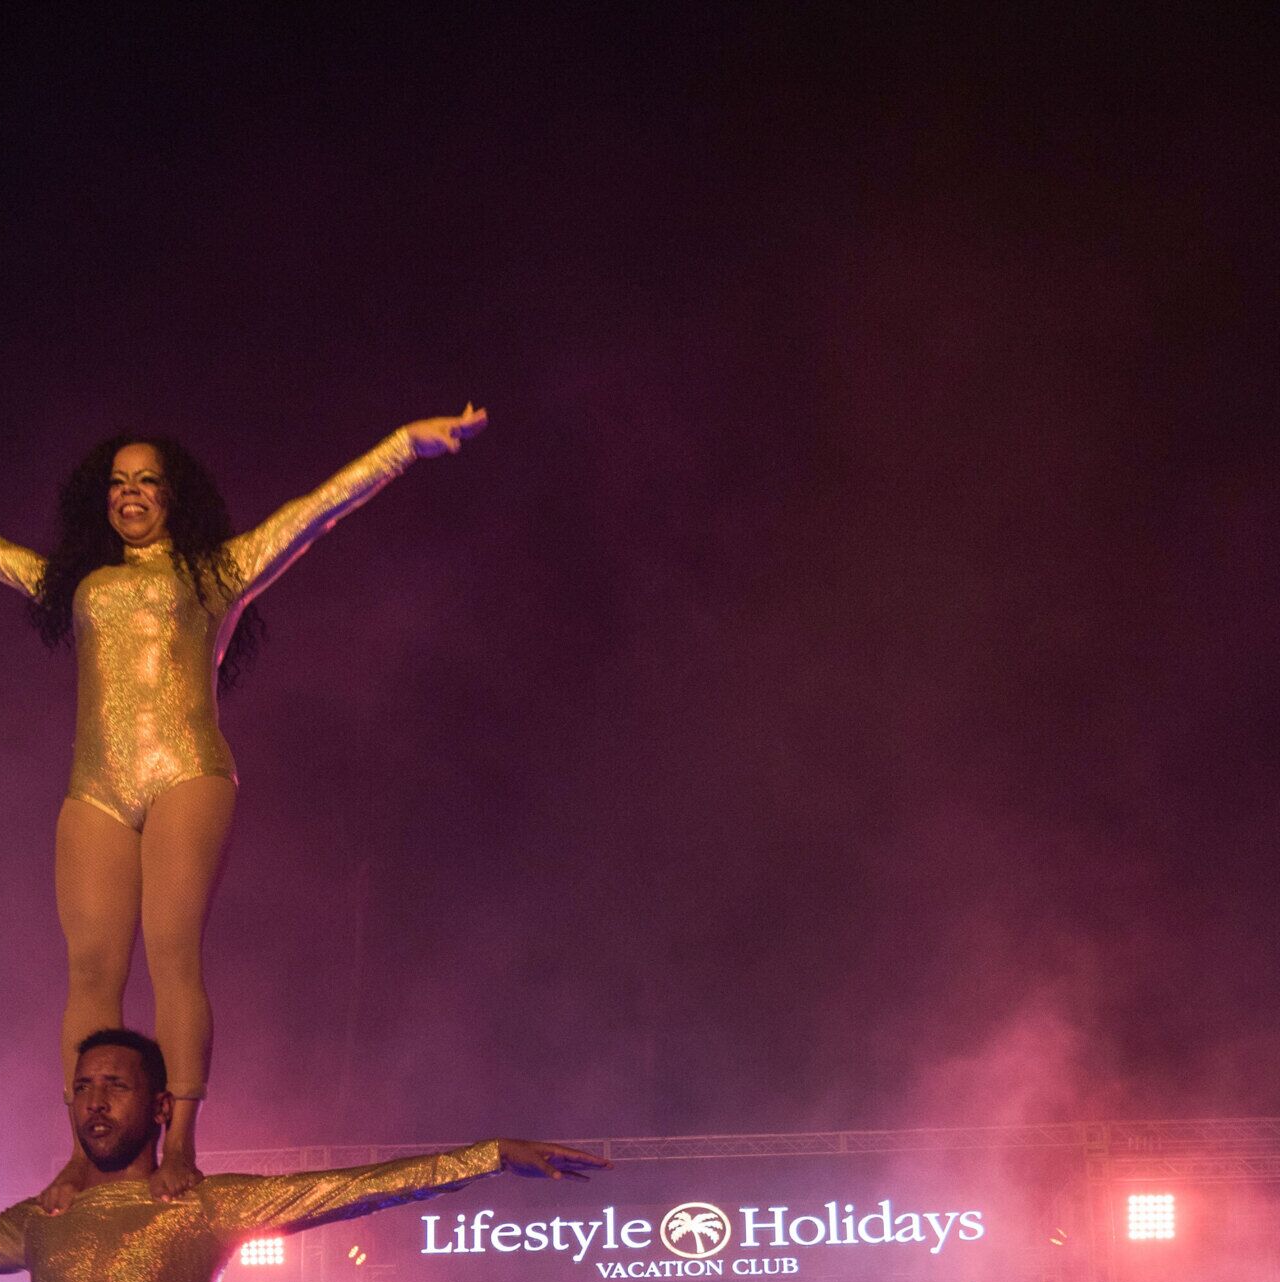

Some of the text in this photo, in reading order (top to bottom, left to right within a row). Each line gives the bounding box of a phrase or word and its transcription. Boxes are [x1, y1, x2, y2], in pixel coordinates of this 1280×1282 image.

[420, 1199, 985, 1262] Lifestyle Holidays
[596, 1257, 799, 1279] VACATION CLUB
